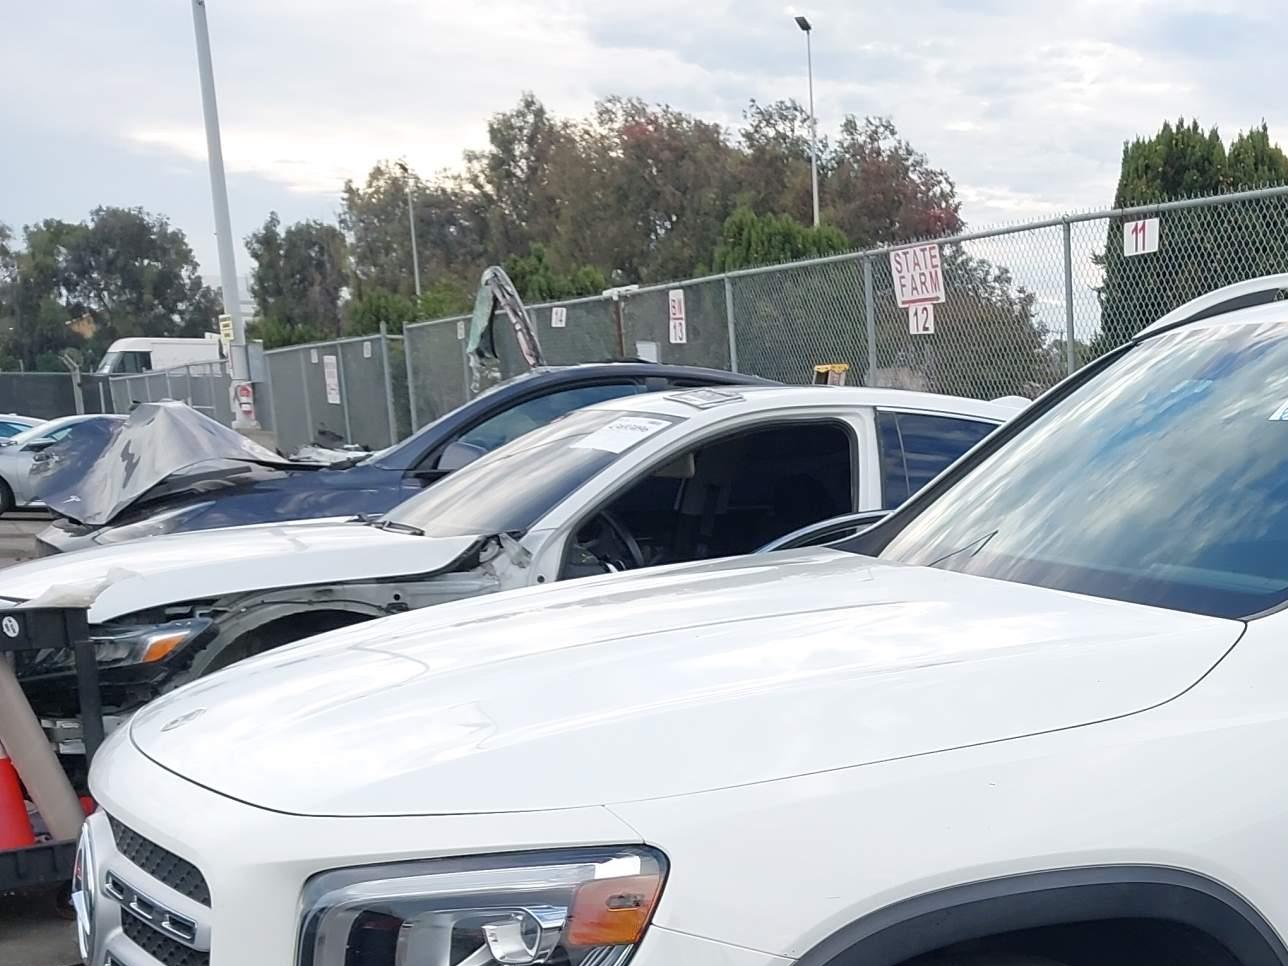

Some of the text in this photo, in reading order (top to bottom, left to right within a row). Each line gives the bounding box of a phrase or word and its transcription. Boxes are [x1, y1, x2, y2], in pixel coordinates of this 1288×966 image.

[1131, 220, 1147, 253] 11
[894, 245, 939, 275] STATE
[898, 269, 941, 298] FARM
[913, 306, 930, 333] 12
